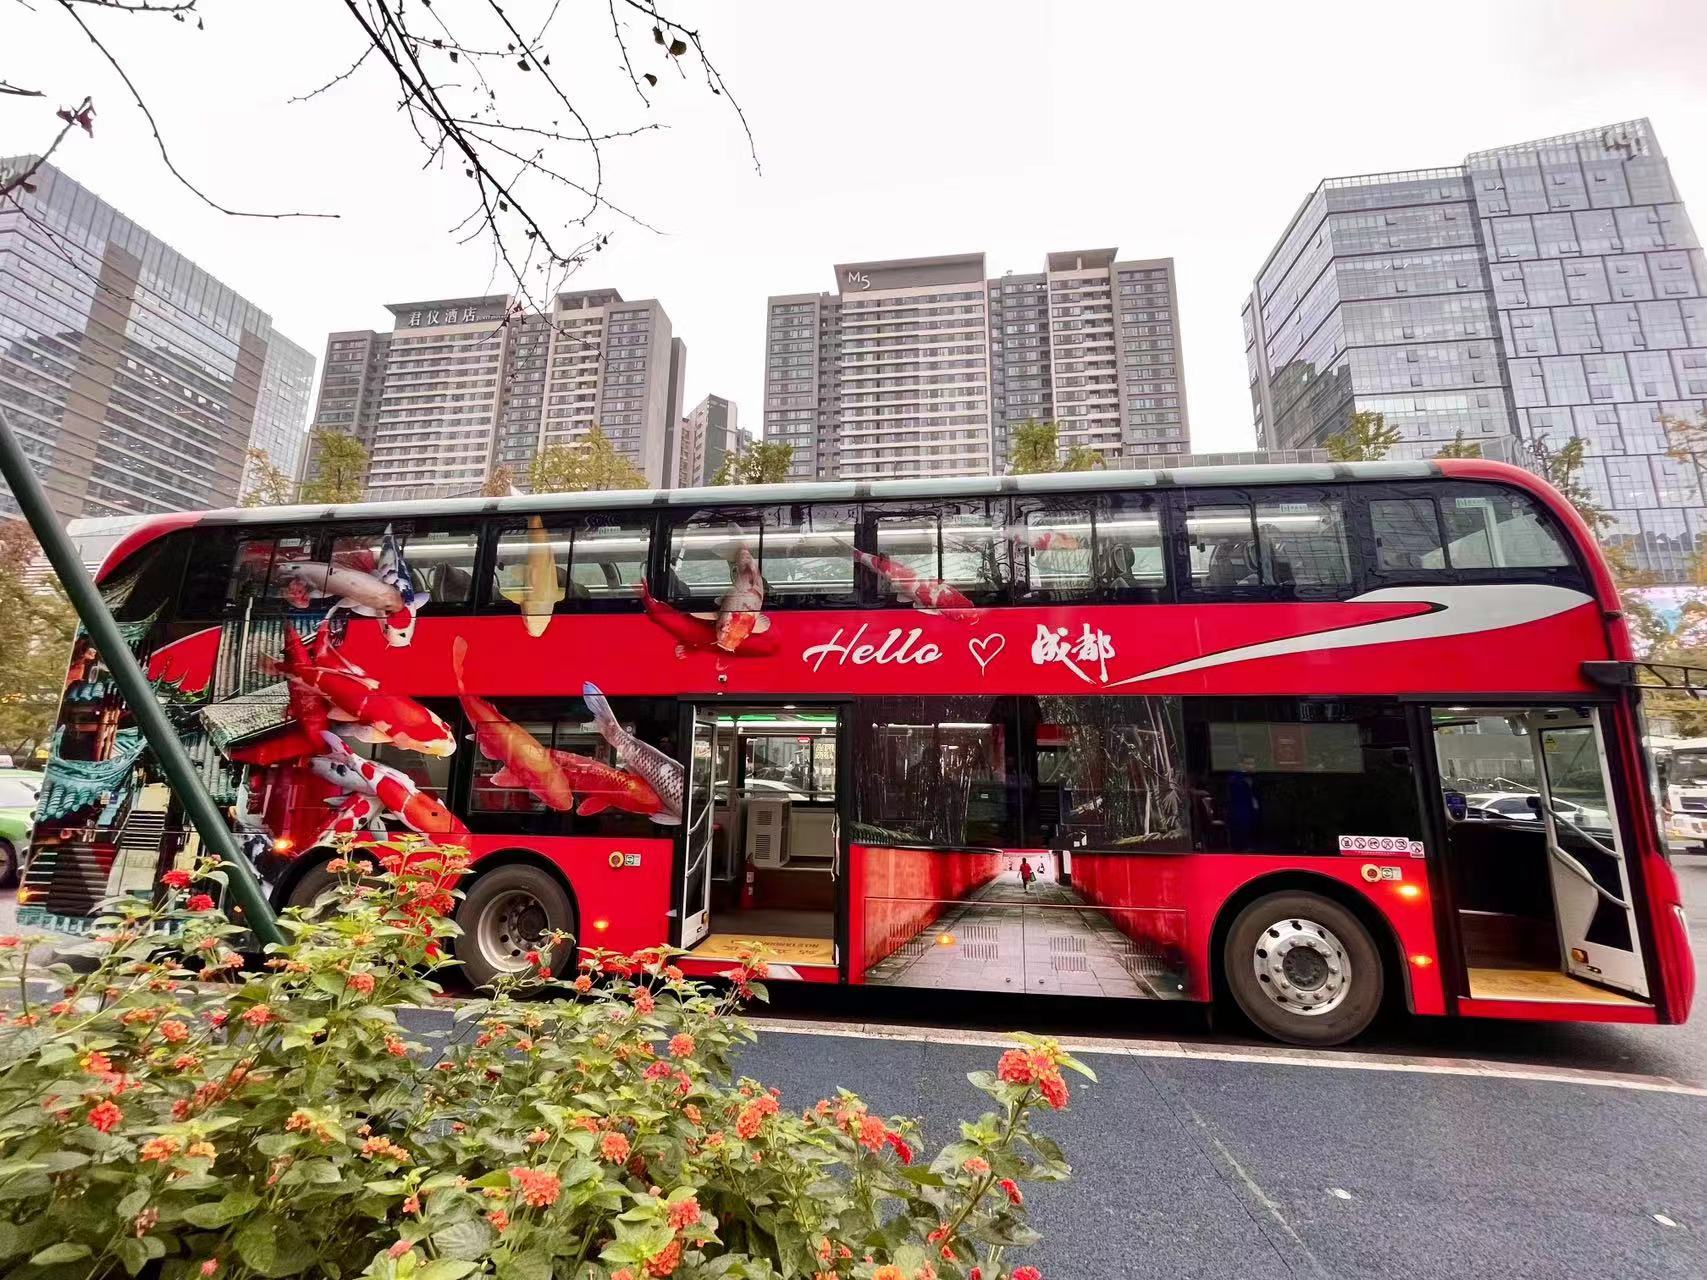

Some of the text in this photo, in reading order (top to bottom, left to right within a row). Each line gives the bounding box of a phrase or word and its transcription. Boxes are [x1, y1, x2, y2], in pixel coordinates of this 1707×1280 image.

[848, 271, 871, 290] M5
[408, 306, 477, 326] 君仪酒店
[802, 622, 944, 673] Hello
[1031, 622, 1116, 685] 成都
